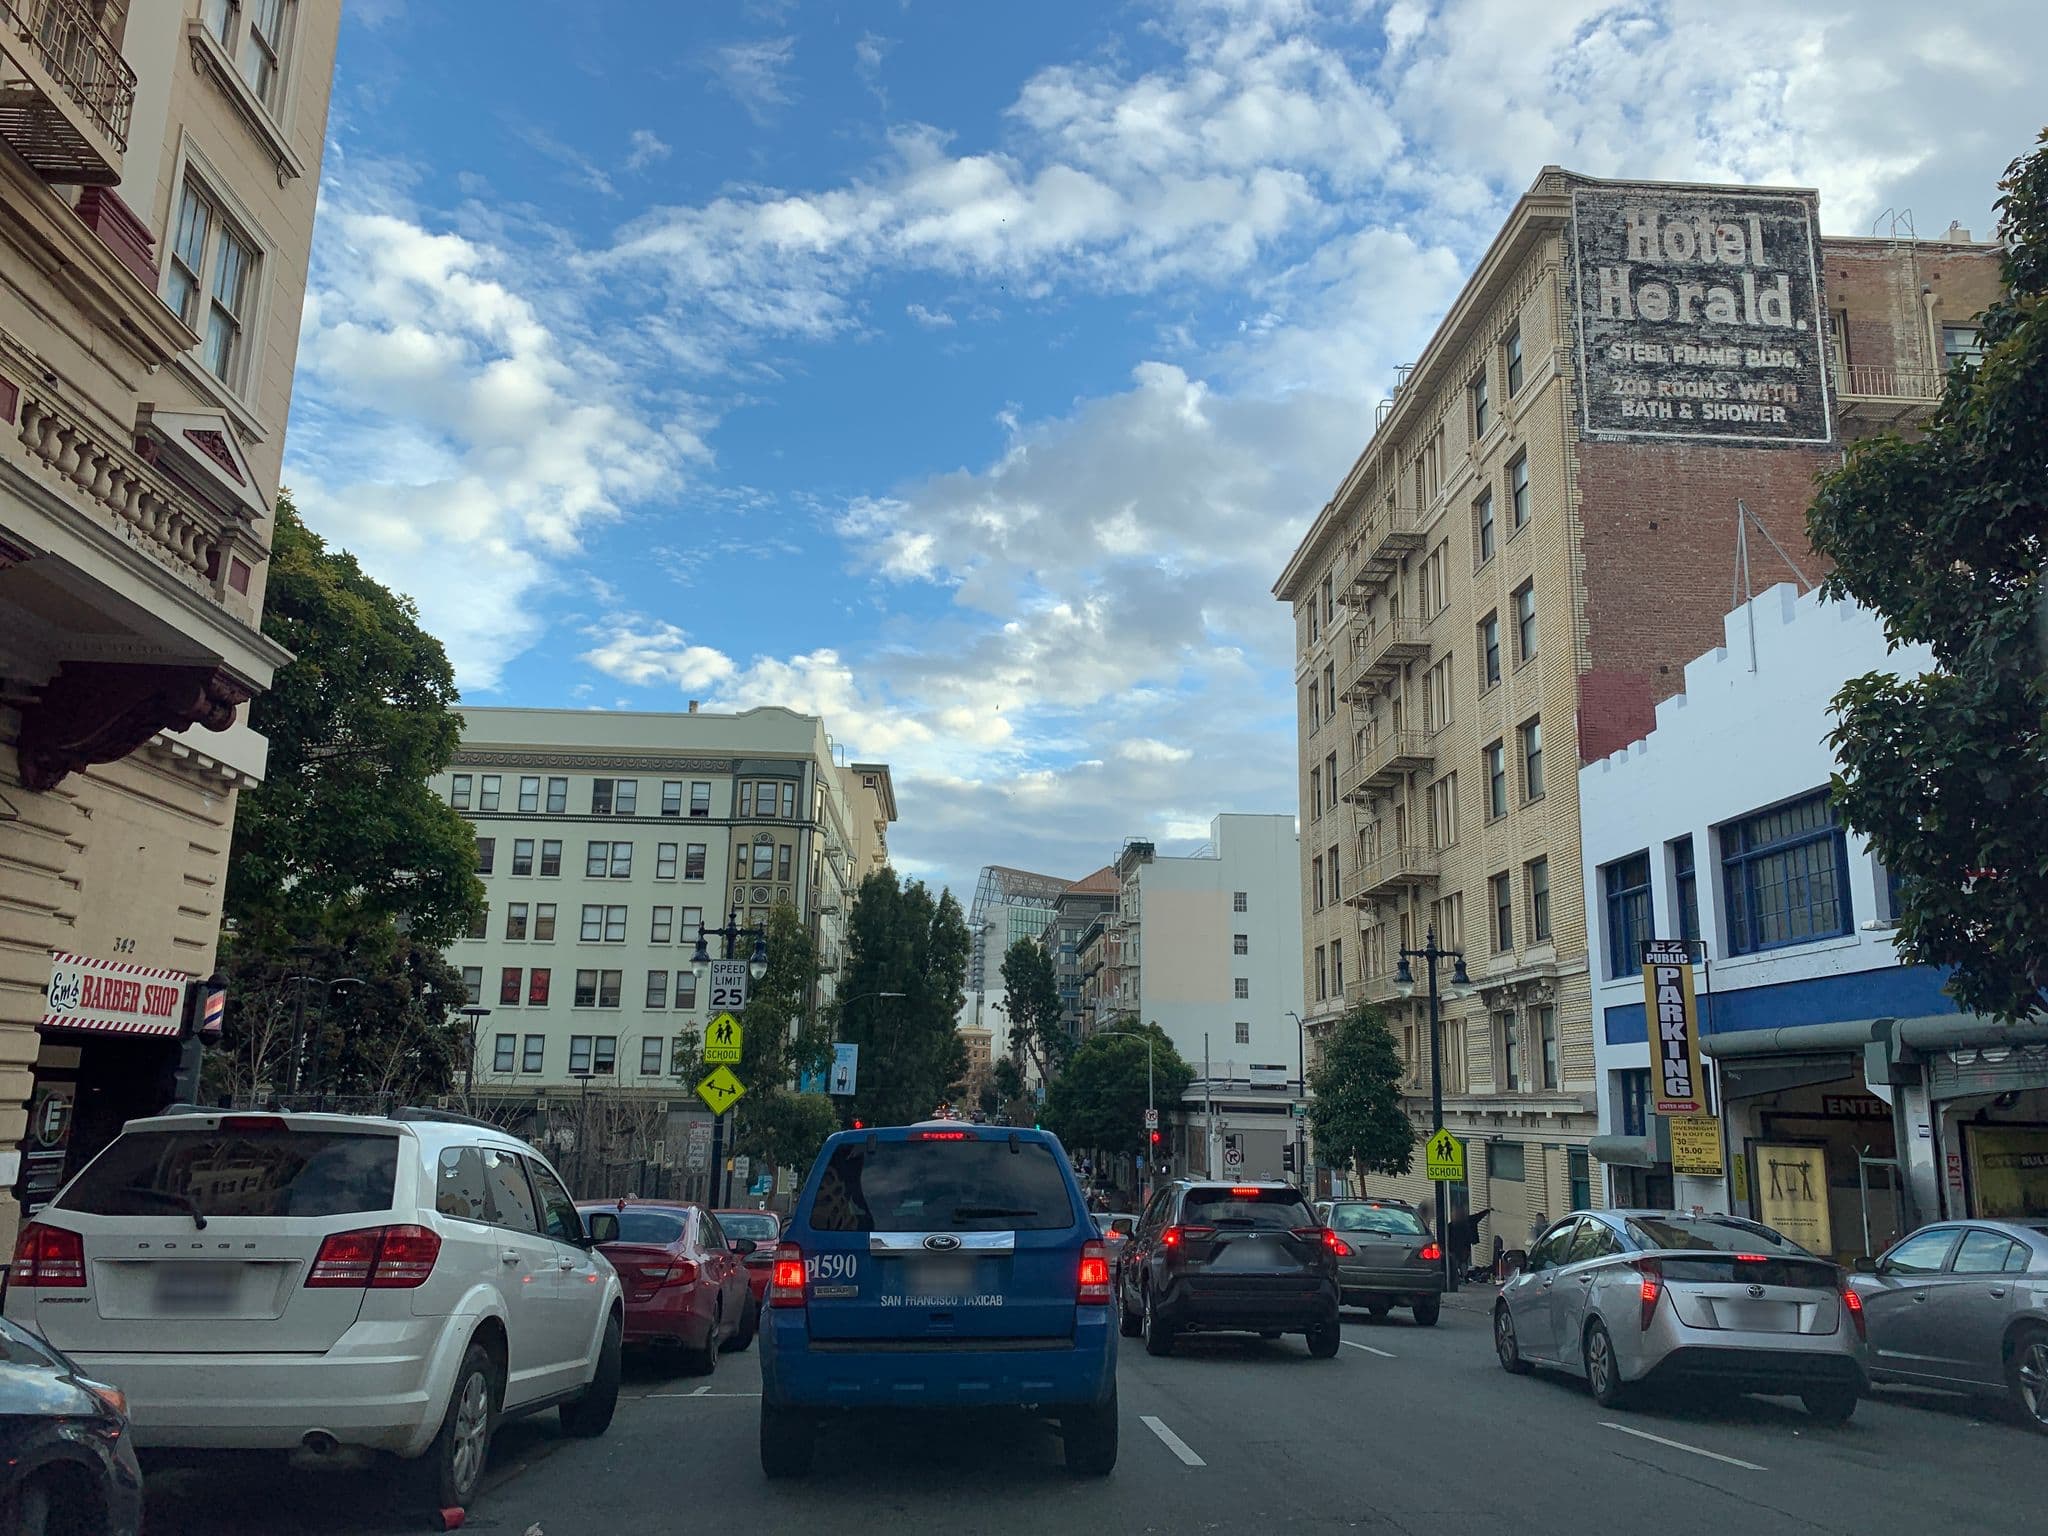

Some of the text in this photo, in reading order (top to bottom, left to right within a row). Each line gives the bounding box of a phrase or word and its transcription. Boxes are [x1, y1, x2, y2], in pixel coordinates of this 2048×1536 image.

[1624, 208, 1768, 267] Hotel
[1599, 265, 1808, 330] Herald.
[1609, 343, 1669, 363] STEEL
[1673, 346, 1740, 366] FRAME
[1612, 377, 1798, 403] 200 ROOMS WITH
[1621, 400, 1788, 424] BATH & SHOWER
[113, 937, 136, 954] 342
[1650, 941, 1682, 953] EZ
[1646, 953, 1688, 964] PUBLIC
[713, 964, 746, 974] SPEED
[715, 976, 742, 986] LIMIT
[49, 972, 179, 1017] Em's BARBER SHOP
[712, 988, 743, 1006] 25
[1656, 967, 1692, 1097] PARKING
[706, 1050, 739, 1060] SCHOOL
[1429, 1167, 1462, 1177] SCHOOL
[1947, 1154, 1962, 1189] EXIT
[880, 1295, 901, 1307] SAN
